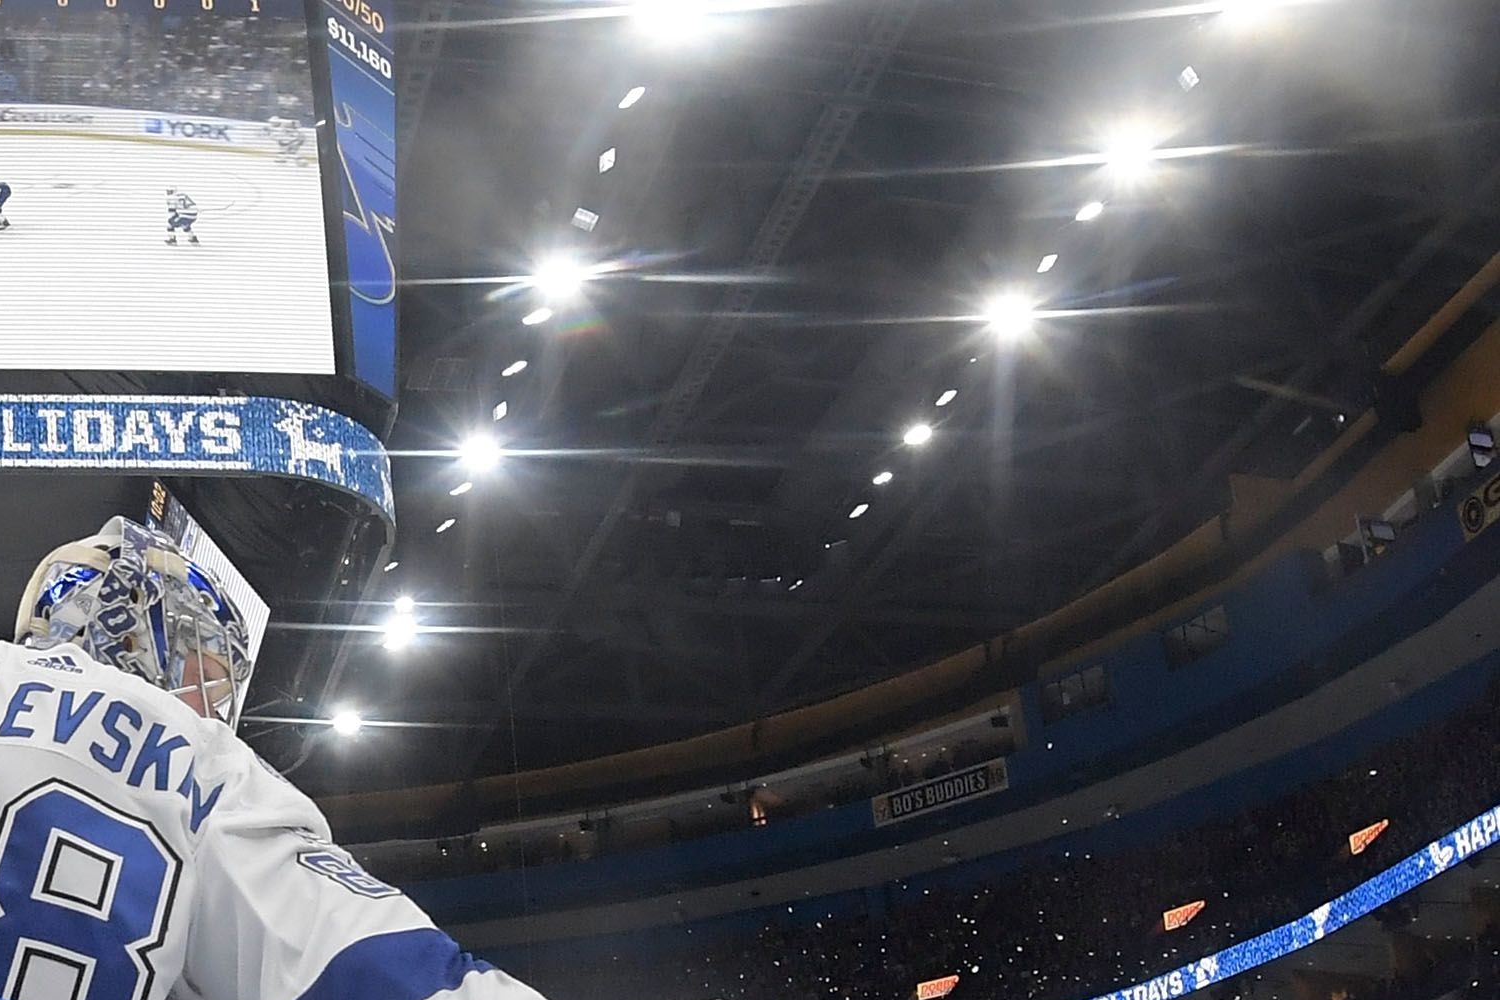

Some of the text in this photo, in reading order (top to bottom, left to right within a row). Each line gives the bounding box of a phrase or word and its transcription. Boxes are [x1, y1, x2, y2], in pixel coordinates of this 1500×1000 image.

[337, 0, 384, 33] 0/50
[327, 17, 392, 79] $11,160
[166, 118, 231, 142] YORK
[26, 656, 84, 675] adidas
[892, 771, 986, 816] BO'S BUDDIES
